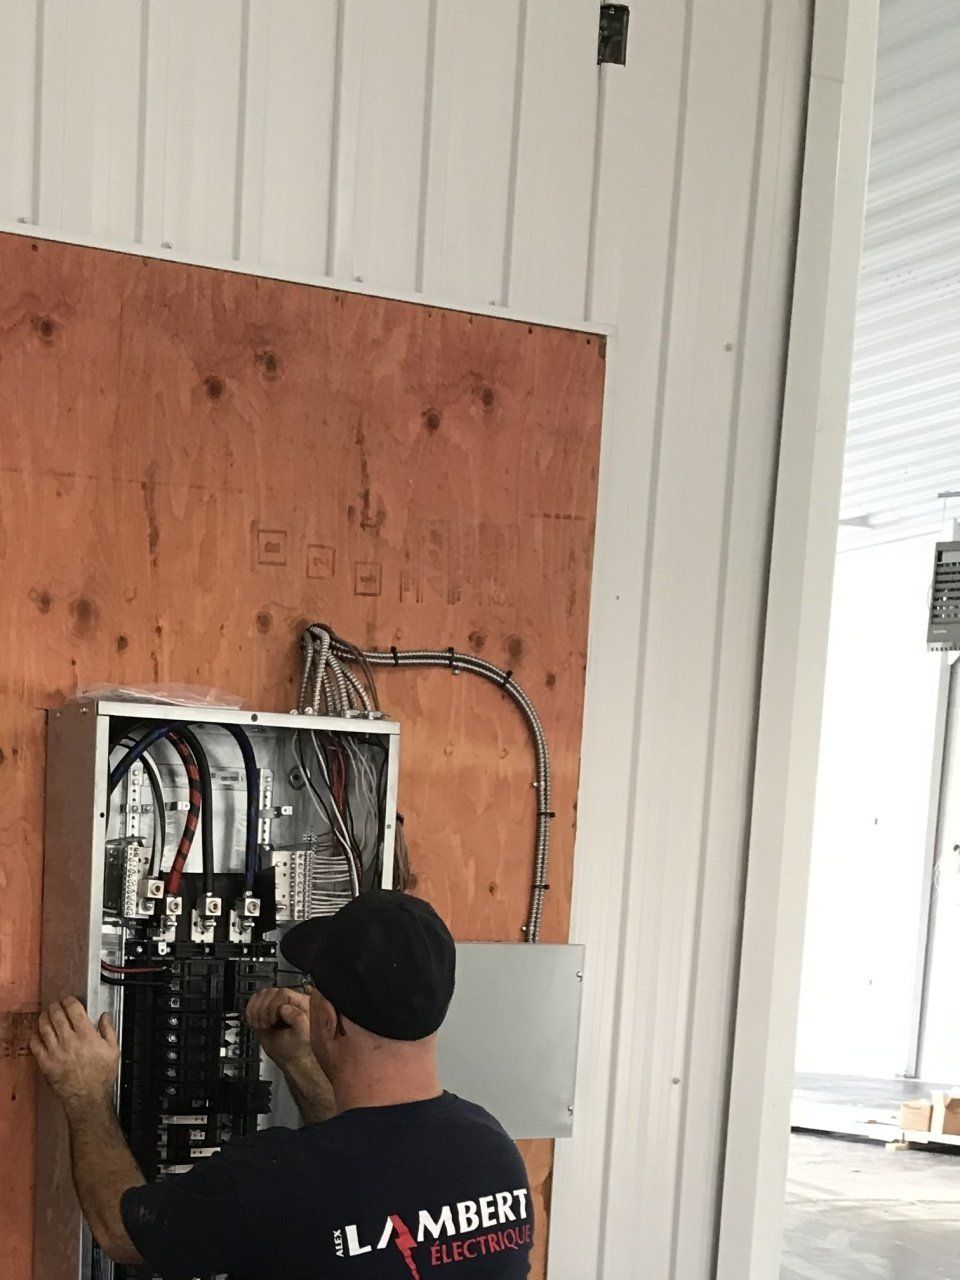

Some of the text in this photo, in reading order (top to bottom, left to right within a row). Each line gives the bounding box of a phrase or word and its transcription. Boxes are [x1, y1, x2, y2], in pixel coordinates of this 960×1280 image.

[332, 1229, 345, 1258] ALEX
[345, 1188, 528, 1260] LAMBERT
[429, 1224, 531, 1267] ÉLECTRIQUE
